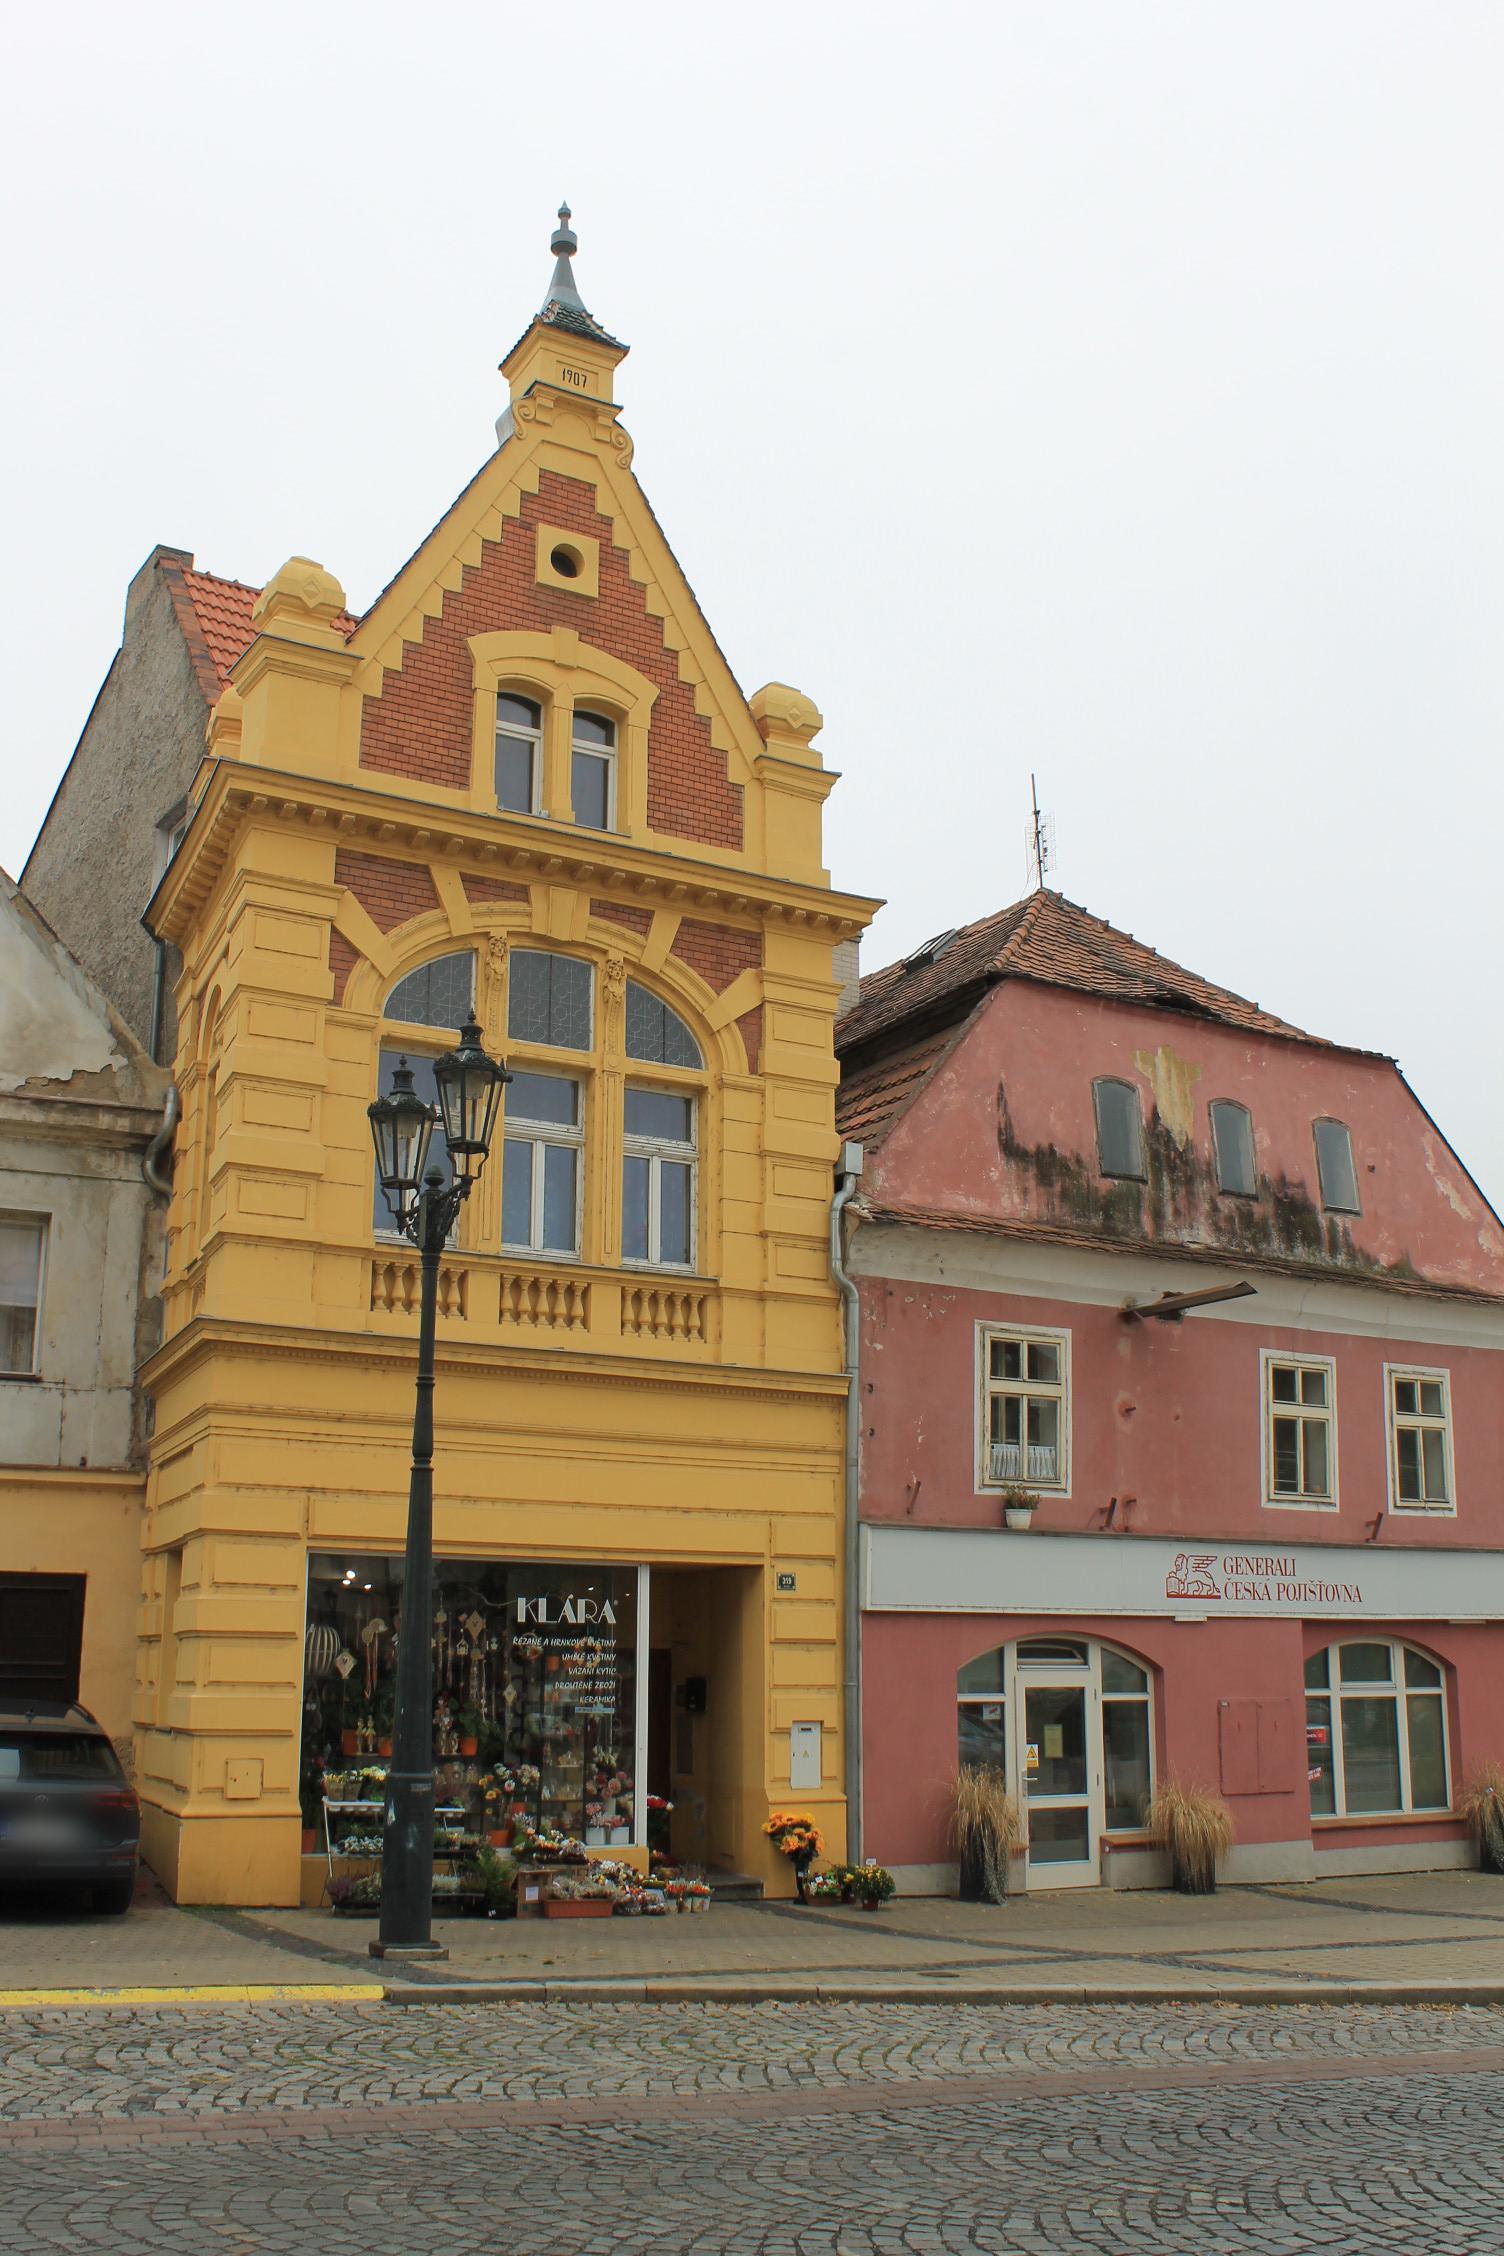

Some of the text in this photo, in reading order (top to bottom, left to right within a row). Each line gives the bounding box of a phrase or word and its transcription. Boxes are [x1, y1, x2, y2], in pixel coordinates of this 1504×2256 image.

[562, 368, 587, 388] 1907
[1223, 1556, 1297, 1577] GENERALI
[1224, 1578, 1363, 1602] ČESKÁ POJIŠŤOVNA
[517, 1594, 616, 1624] KLÁRA
[579, 1695, 616, 1704] KERAMIKA
